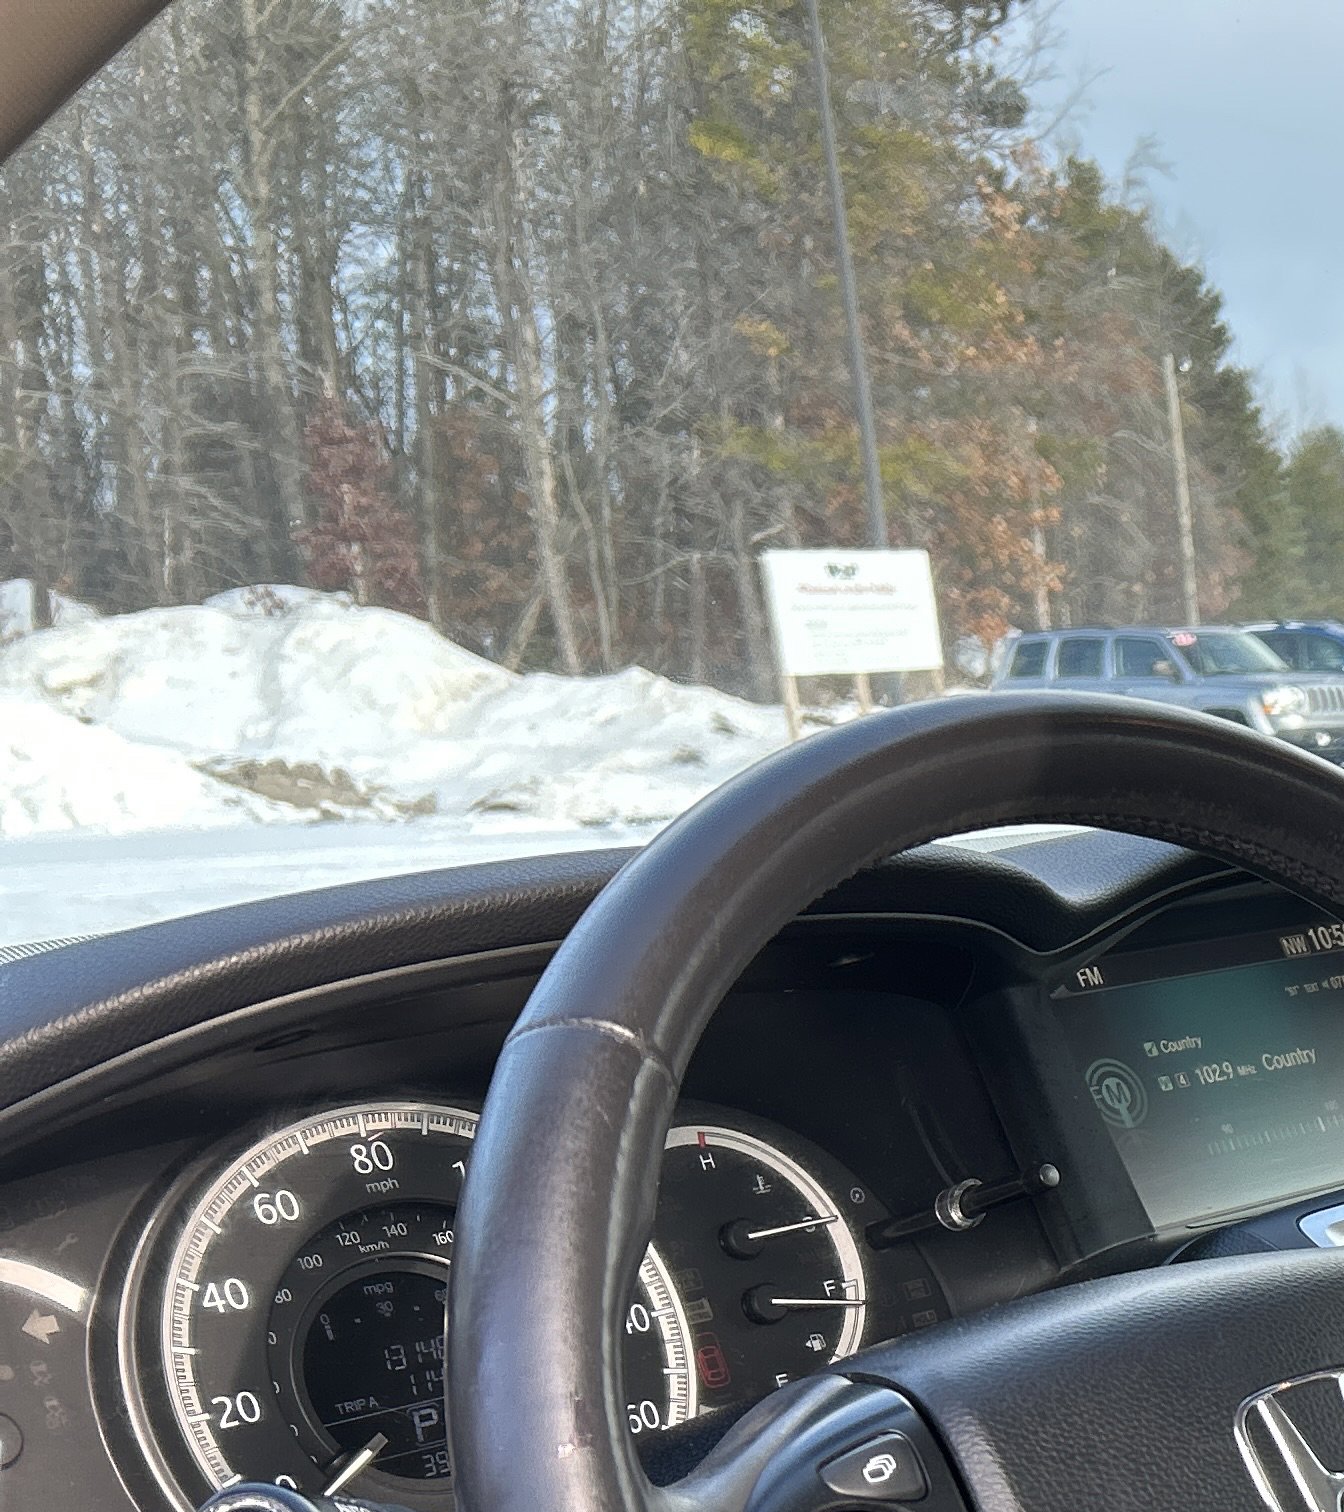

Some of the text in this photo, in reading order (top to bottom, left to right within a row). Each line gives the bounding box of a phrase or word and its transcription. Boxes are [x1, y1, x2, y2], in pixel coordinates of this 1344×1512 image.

[1076, 966, 1104, 988] FM
[1159, 1035, 1202, 1055] Country
[1261, 1047, 1318, 1072] Country
[349, 1140, 394, 1175] 80
[699, 1152, 717, 1172] H
[365, 1177, 400, 1195] mph
[252, 1189, 301, 1226] 60
[335, 1222, 455, 1247] 120 140 160
[358, 1239, 390, 1254] km/h
[297, 1253, 323, 1271] 100
[201, 1276, 250, 1314] 40
[363, 1281, 394, 1296] mpg
[823, 1279, 836, 1298] F
[212, 1391, 261, 1429] 20
[335, 1396, 380, 1416] TRIP A
[413, 1407, 439, 1443] P
